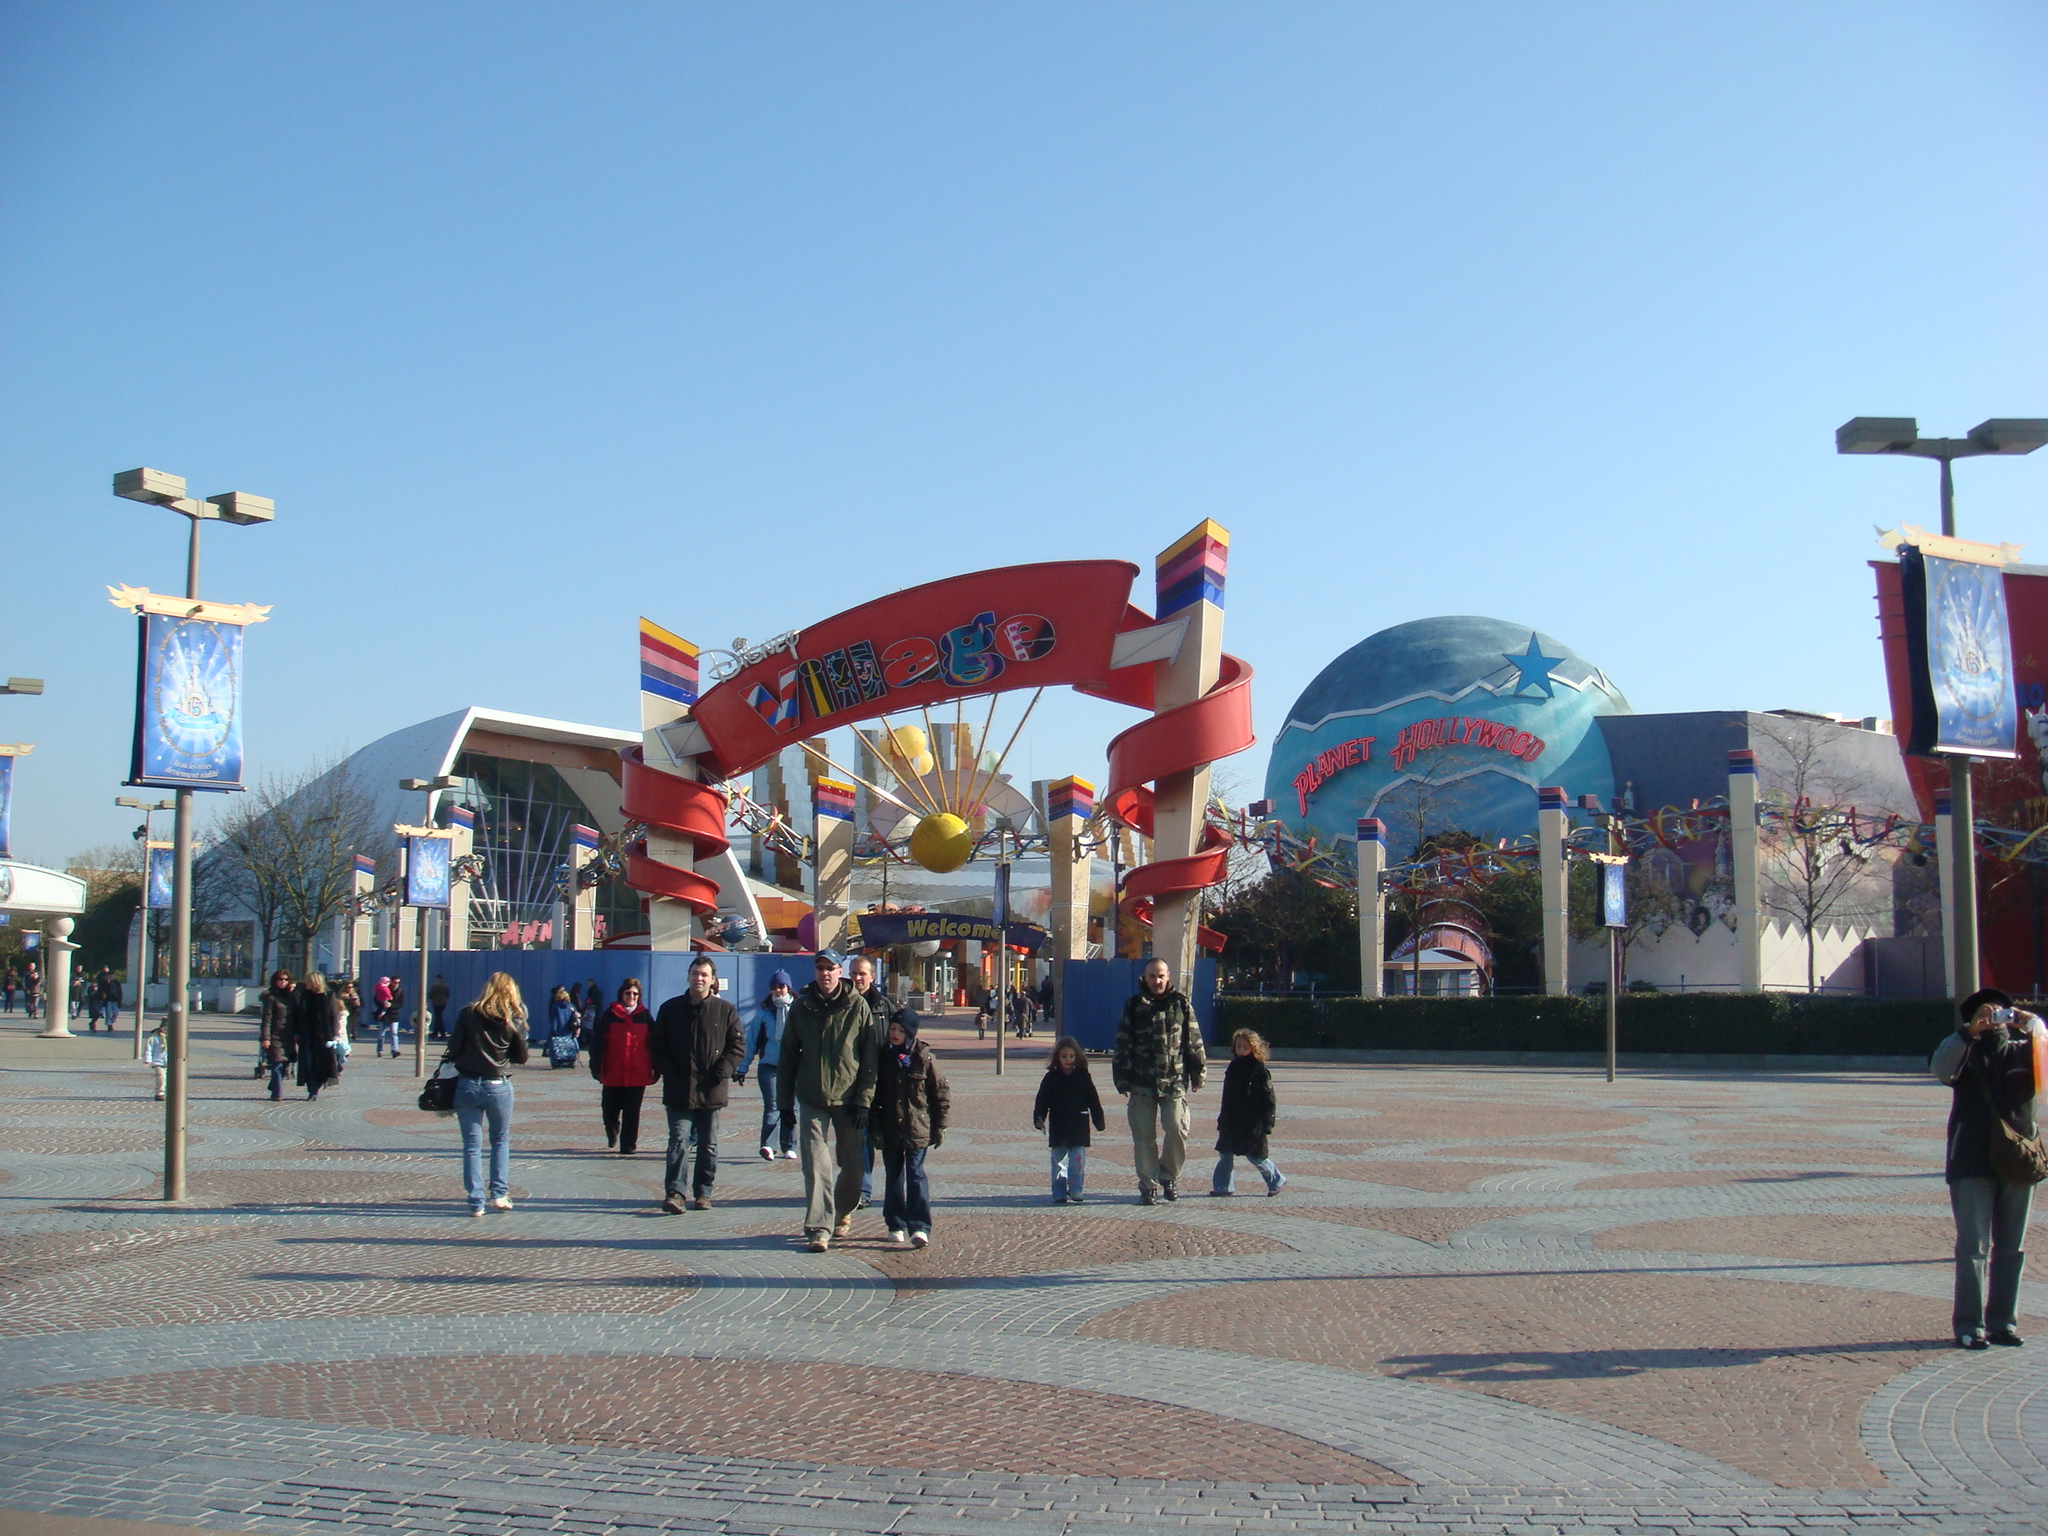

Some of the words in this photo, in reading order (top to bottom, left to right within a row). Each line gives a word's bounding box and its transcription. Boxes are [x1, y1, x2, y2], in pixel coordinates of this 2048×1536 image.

[738, 611, 1055, 735] Village
[1292, 736, 1376, 818] PLANET
[1389, 717, 1546, 772] HOLLYWOOD
[907, 918, 1001, 940] Welcome
[1391, 930, 1434, 960] RESTAUANT
